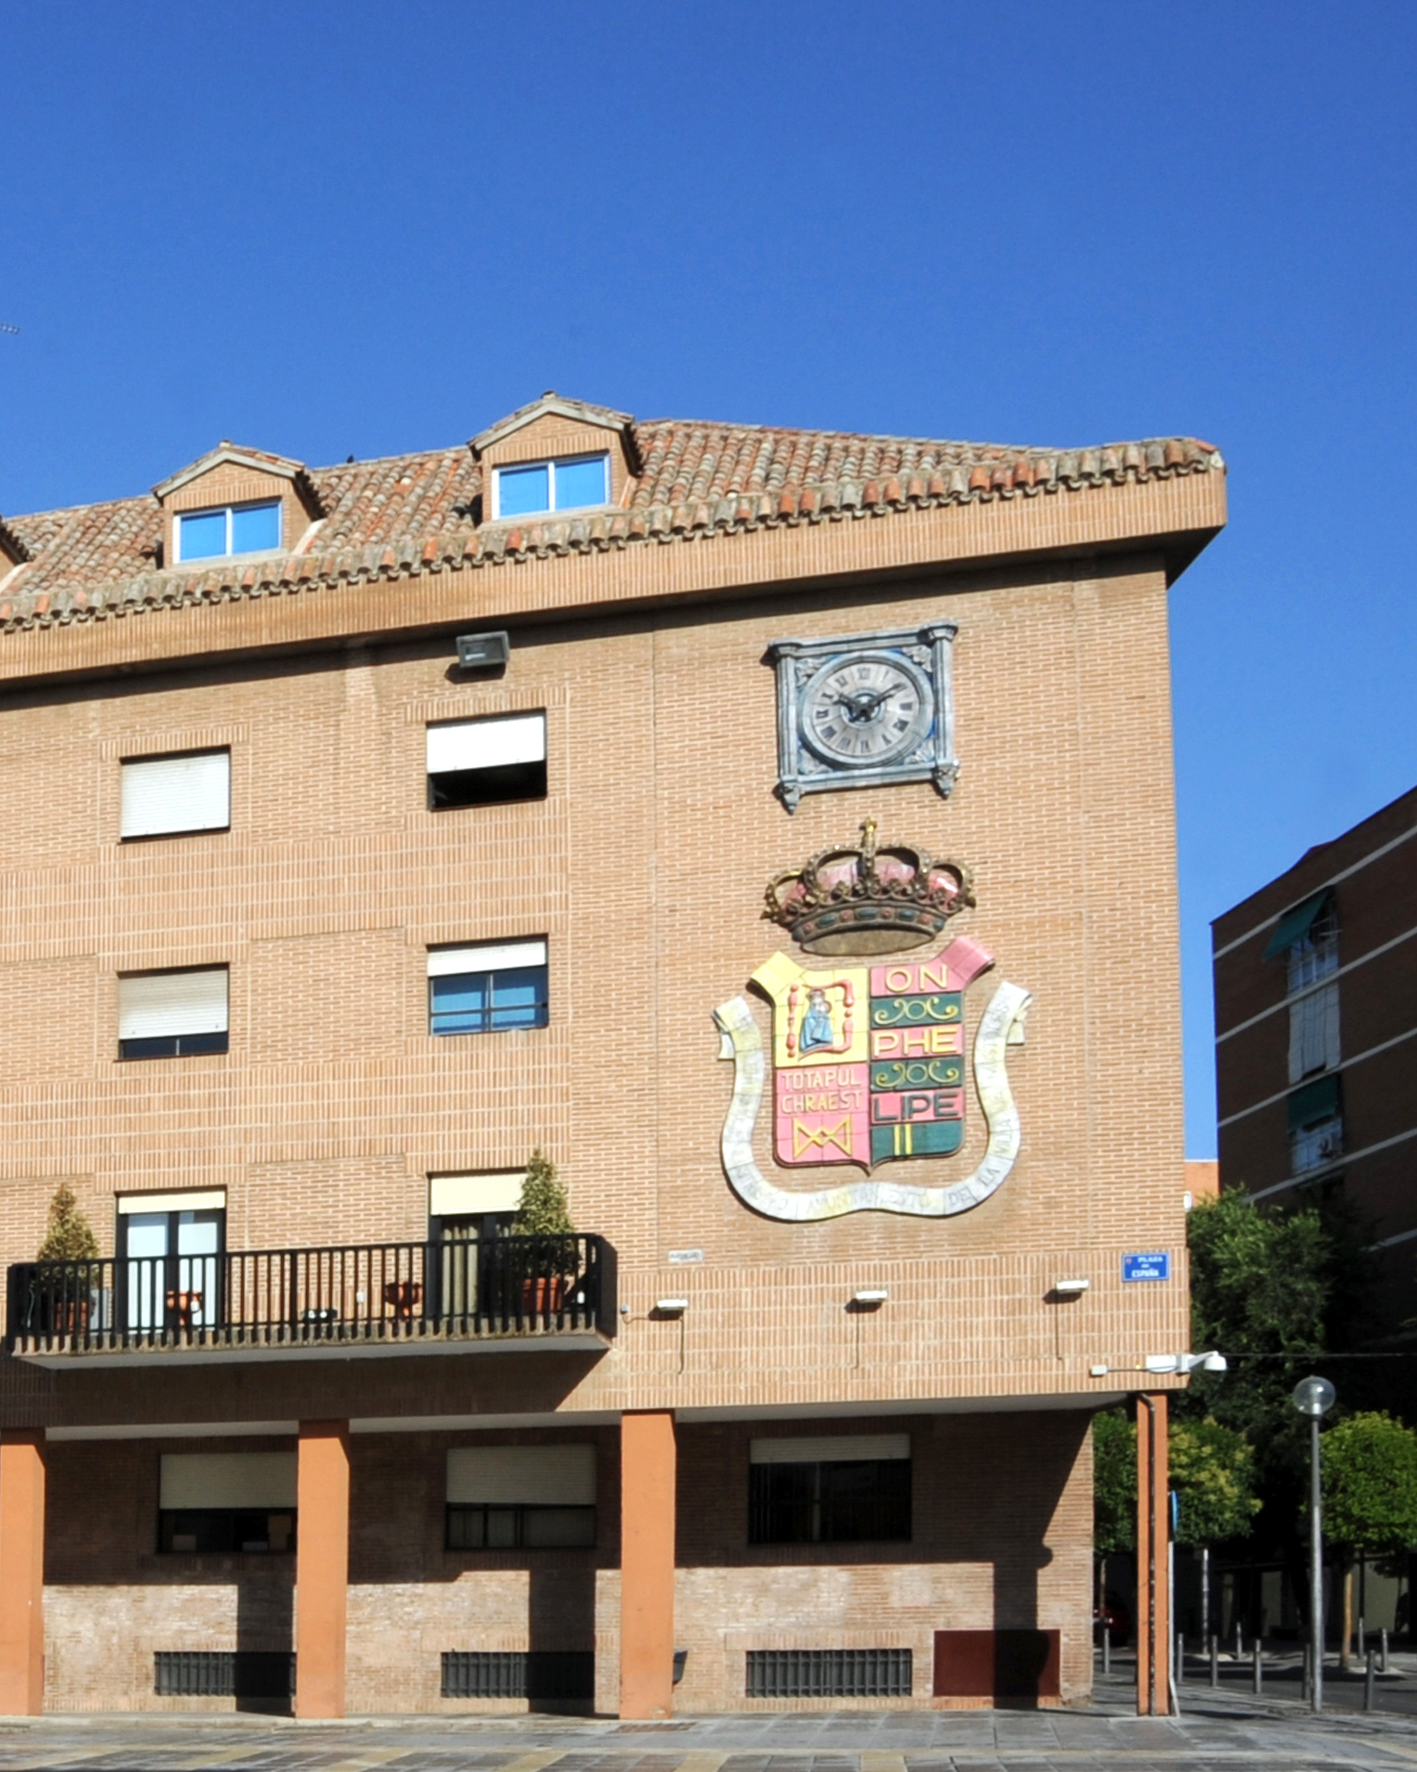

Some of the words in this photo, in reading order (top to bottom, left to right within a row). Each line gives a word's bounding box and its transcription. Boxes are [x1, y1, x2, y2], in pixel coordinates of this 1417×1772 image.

[885, 963, 949, 993] ON
[873, 1026, 959, 1058] PHE
[782, 1067, 862, 1092] TOTAPUL
[781, 1090, 863, 1115] CHRAEST
[873, 1090, 960, 1123] LIPE
